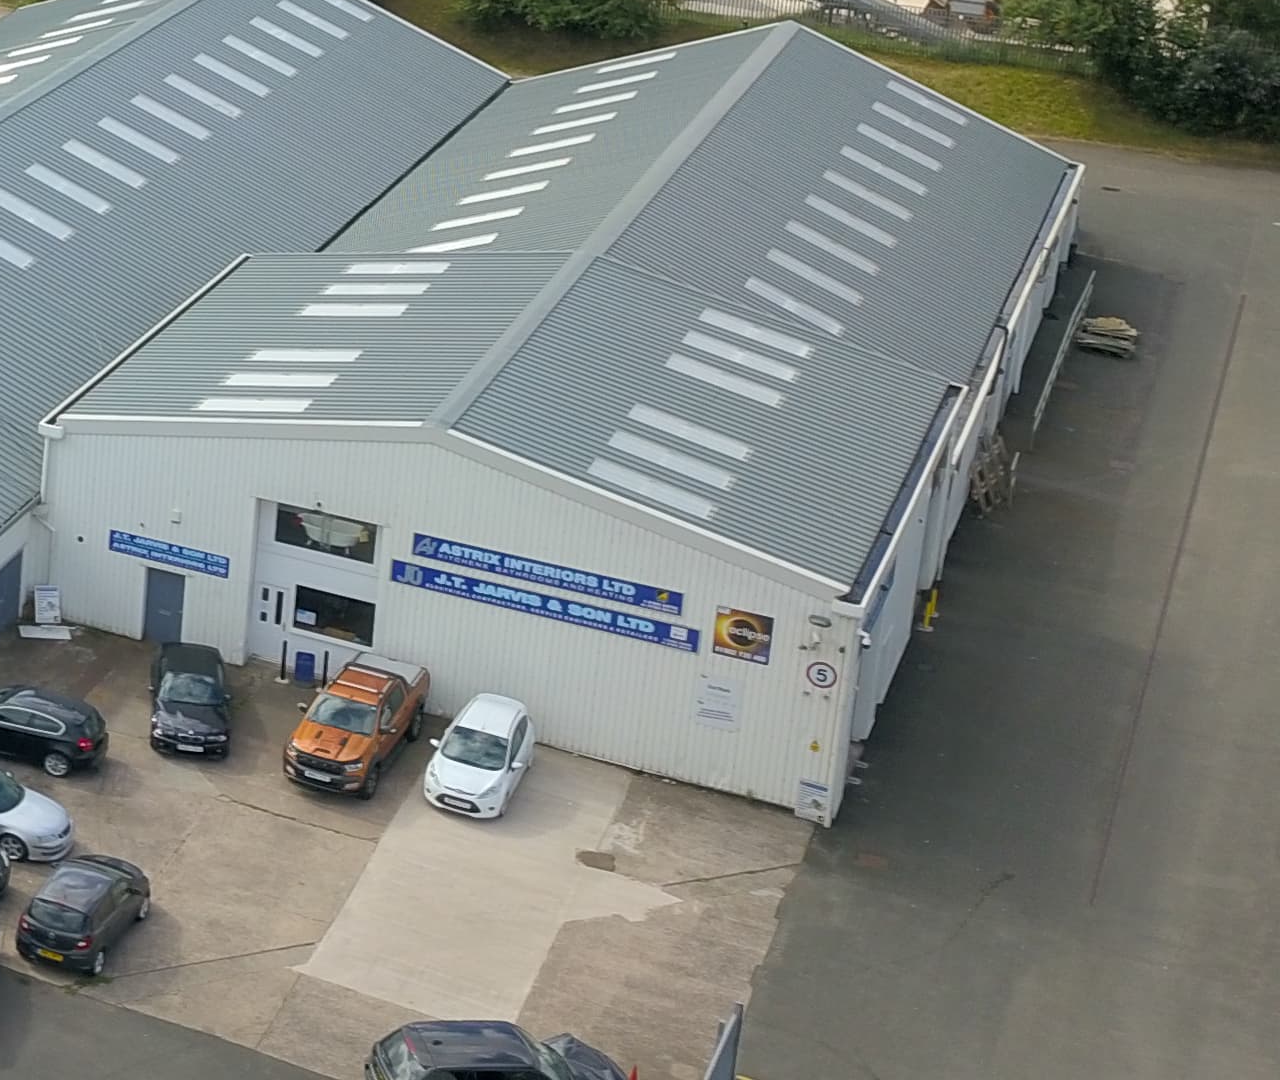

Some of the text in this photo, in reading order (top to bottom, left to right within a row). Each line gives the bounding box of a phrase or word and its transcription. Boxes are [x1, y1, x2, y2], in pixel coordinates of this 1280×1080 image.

[438, 542, 501, 565] ASTRIX
[503, 557, 599, 588] INTERIORS
[602, 579, 636, 596] LTD
[434, 574, 468, 590] J.T.
[473, 582, 542, 607] JARVIS
[546, 599, 562, 612] &
[568, 603, 612, 623] SON
[617, 615, 655, 633] LTD
[728, 625, 770, 643] eclipse
[816, 668, 828, 683] 5
